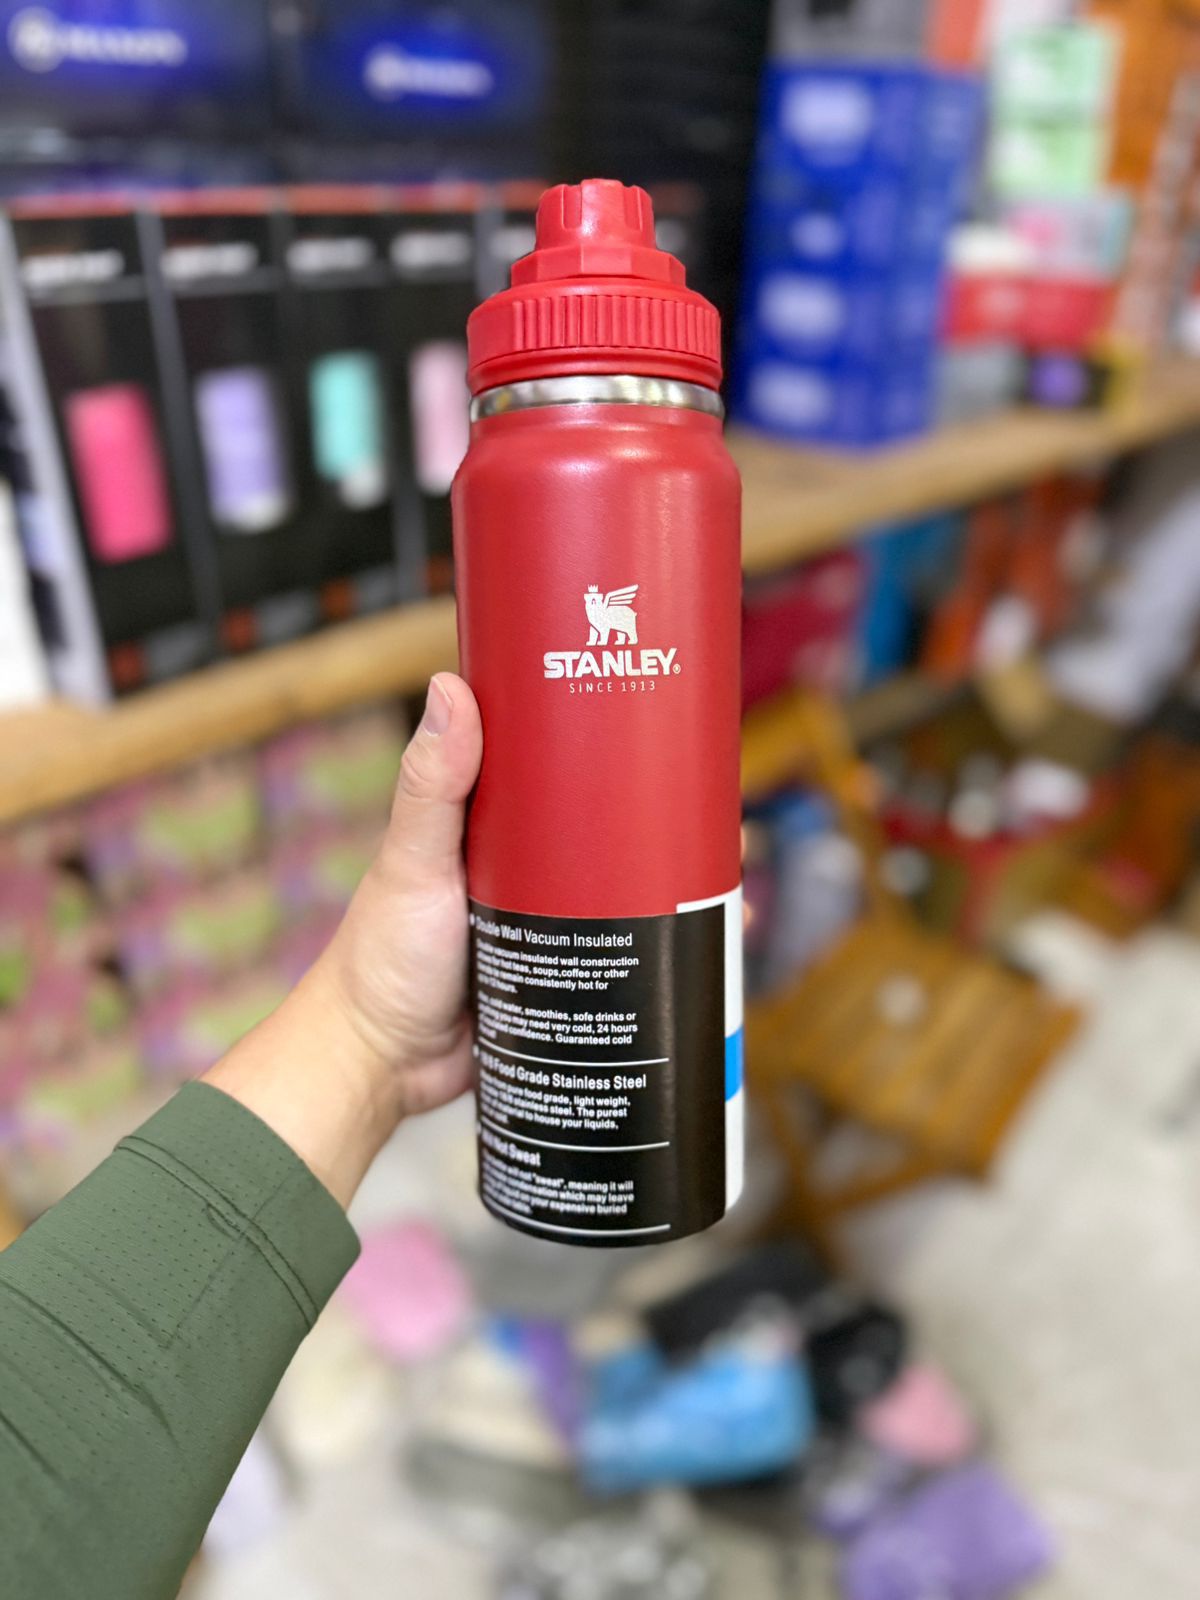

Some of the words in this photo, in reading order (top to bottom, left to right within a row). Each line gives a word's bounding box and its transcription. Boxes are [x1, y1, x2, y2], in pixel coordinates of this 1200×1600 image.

[569, 682, 613, 694] SINCE
[622, 680, 656, 692] 1913
[500, 924, 522, 941] Wall
[524, 928, 570, 947] Vacuum
[574, 932, 633, 947] Insulated
[520, 951, 558, 965] insulated
[560, 957, 578, 966] wall
[580, 956, 639, 967] construction
[592, 970, 602, 978] or
[604, 968, 629, 978] other
[524, 976, 576, 992] consistently
[578, 980, 593, 990] hot
[595, 980, 608, 990] for
[525, 1008, 572, 1022] smoothies,
[573, 1012, 594, 1022] sofe
[595, 1012, 624, 1022] drinks
[626, 1012, 636, 1021] or
[528, 1020, 550, 1031] need
[551, 1023, 570, 1034] very
[572, 1024, 595, 1035] cold,
[597, 1024, 609, 1034] 24
[611, 1024, 638, 1033] hours
[555, 1033, 610, 1045] Guaranteed
[612, 1034, 632, 1045] cold
[516, 1066, 550, 1086] Grade
[552, 1072, 611, 1090] Stainless
[613, 1073, 646, 1090] Steel
[544, 1093, 572, 1106] grade,
[574, 1096, 594, 1106] light
[596, 1096, 631, 1108] weight,
[550, 1104, 575, 1116] steel.
[576, 1107, 596, 1117] The
[596, 1107, 628, 1119] purest
[534, 1113, 560, 1126] house
[562, 1119, 582, 1129] your
[584, 1119, 619, 1131] liquids,
[508, 1142, 541, 1168] Sweat
[610, 1181, 616, 1192] it
[618, 1180, 634, 1191] will
[586, 1194, 606, 1204] may
[608, 1193, 634, 1203] leave
[597, 1203, 628, 1214] buried
